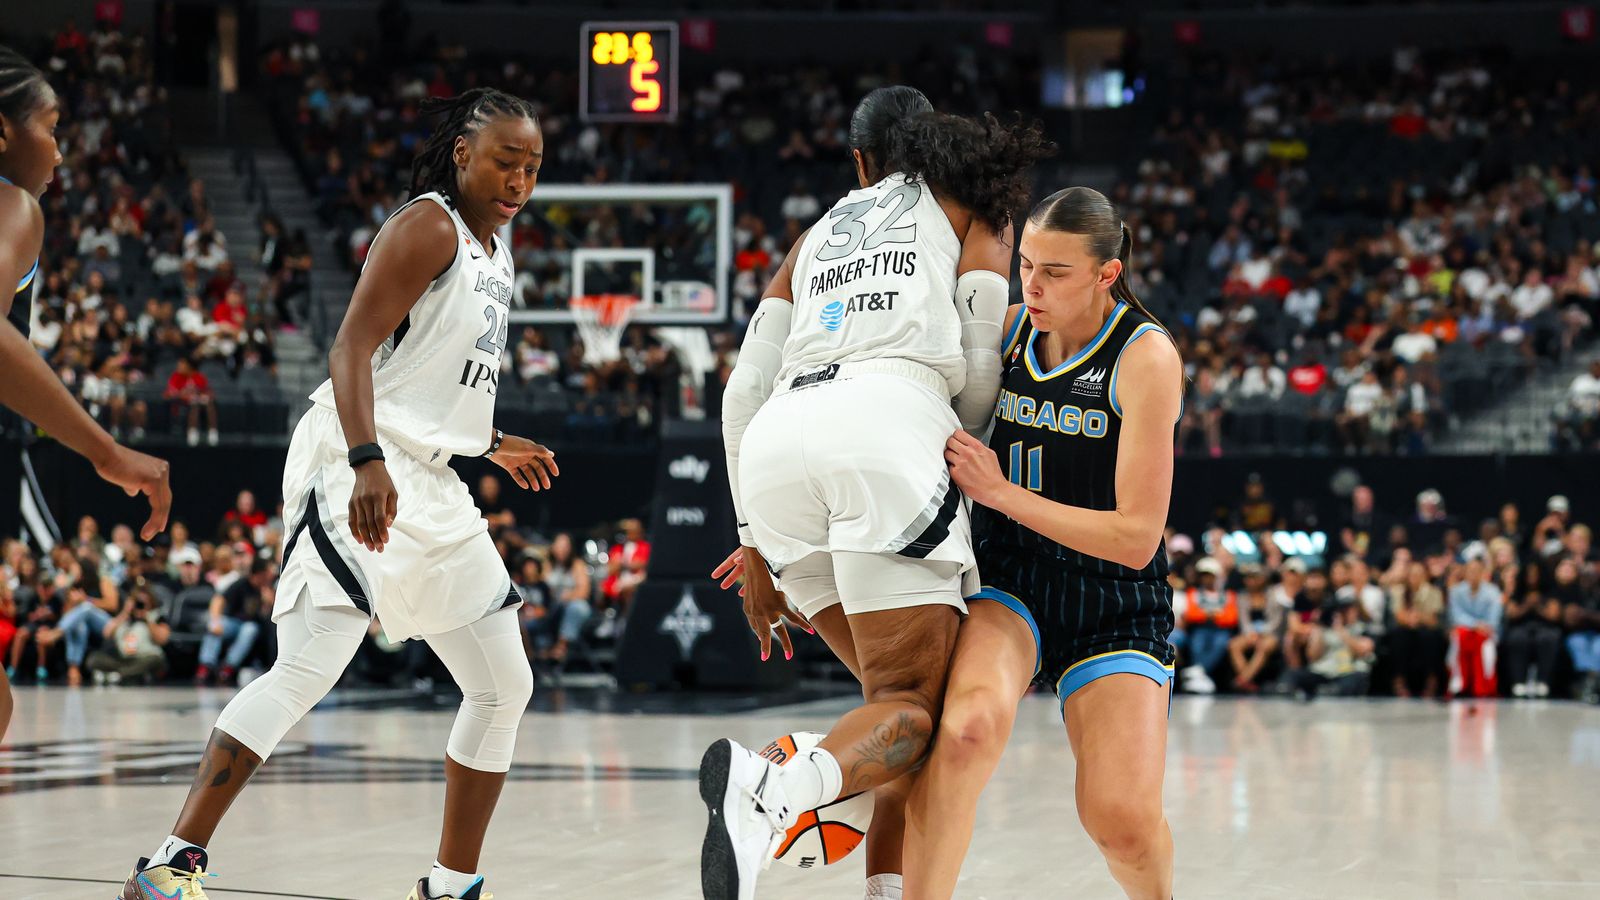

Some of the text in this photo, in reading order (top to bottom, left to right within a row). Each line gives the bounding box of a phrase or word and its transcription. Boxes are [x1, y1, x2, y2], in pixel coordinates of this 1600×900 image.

[630, 60, 661, 112] 5
[815, 181, 921, 261] 32
[809, 251, 917, 298] PARKER-TYUS
[844, 291, 899, 318] AT&T
[475, 304, 509, 362] 24
[458, 359, 499, 396] IPS
[1072, 381, 1103, 391] MAGELLAN
[996, 388, 1109, 439] HICAGO
[1008, 441, 1043, 492] 11
